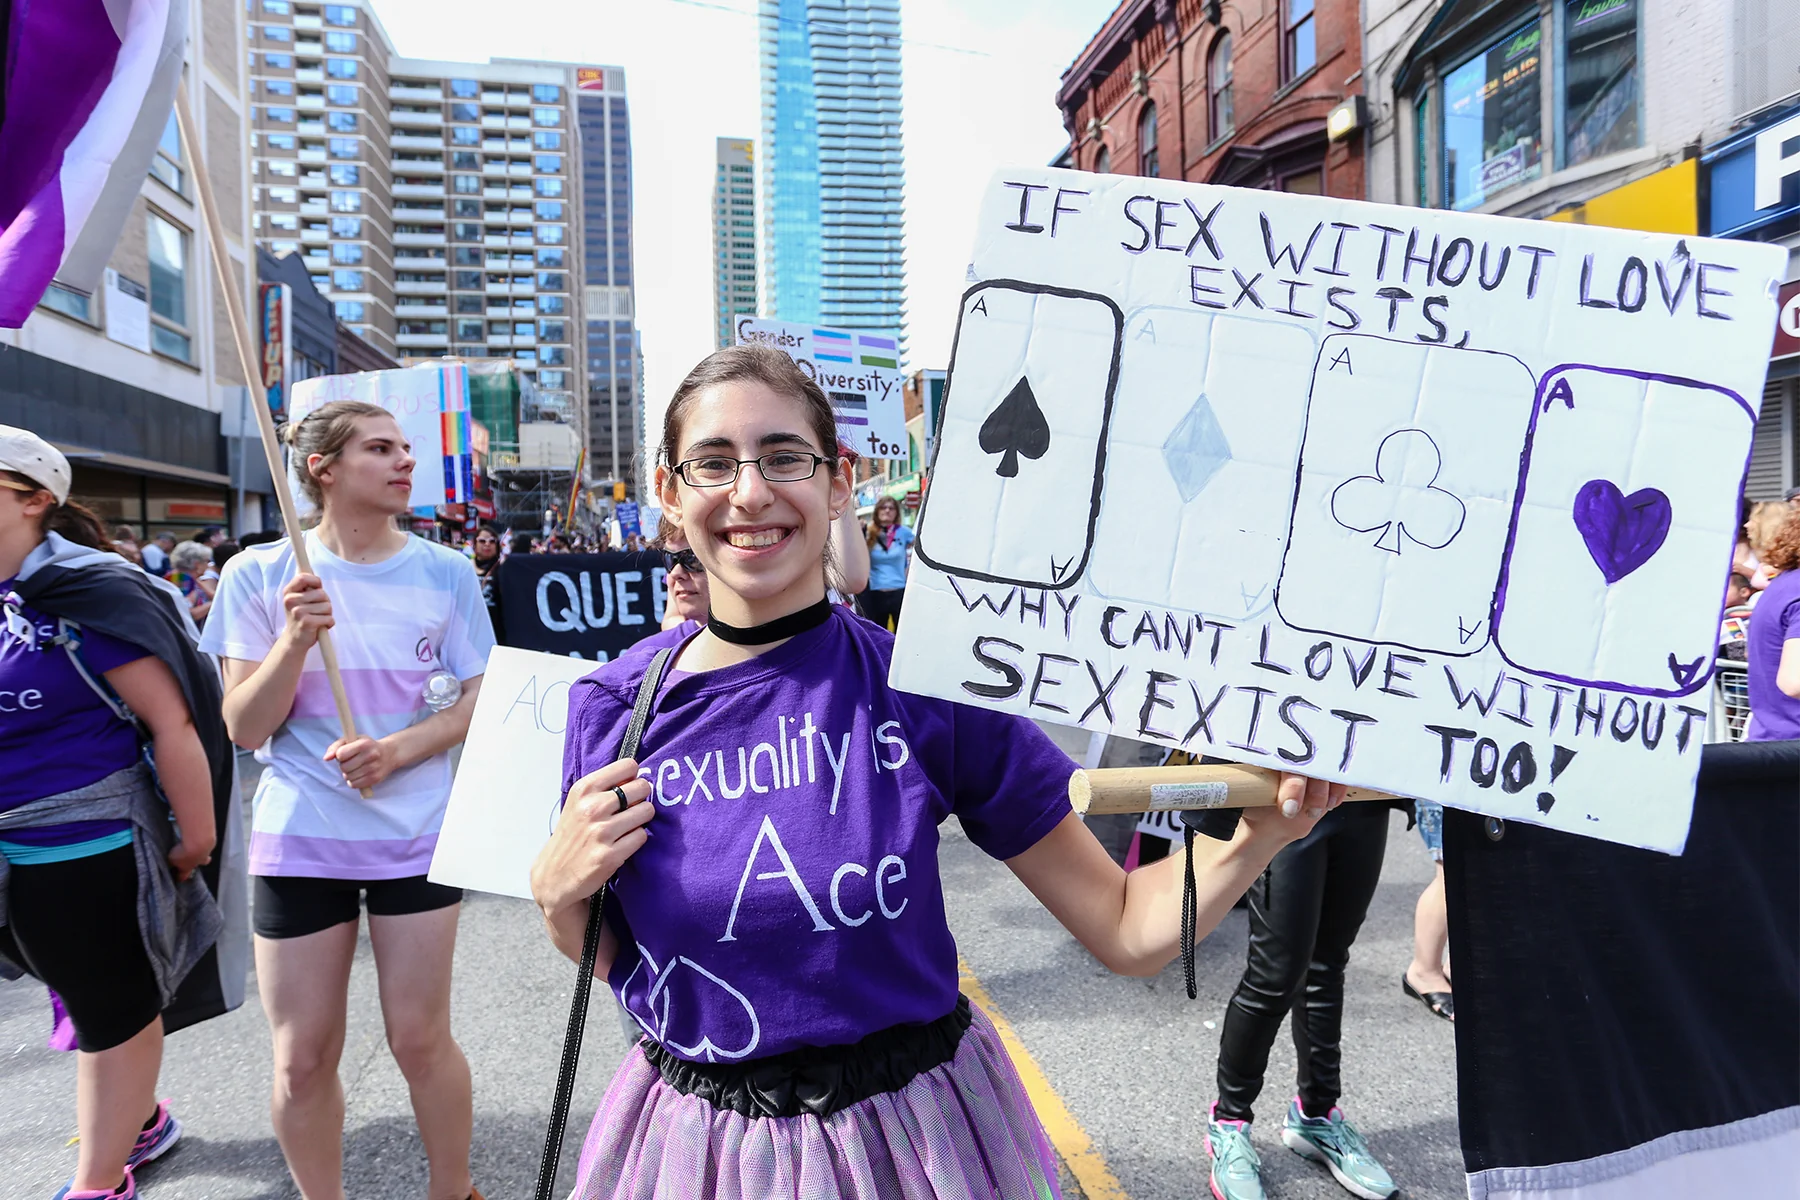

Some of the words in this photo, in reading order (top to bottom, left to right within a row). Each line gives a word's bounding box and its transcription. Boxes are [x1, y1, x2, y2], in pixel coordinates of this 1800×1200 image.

[1003, 181, 1091, 239] IF
[1121, 195, 1226, 261] SEX
[1259, 211, 1556, 300] WITHOUT
[1577, 239, 1739, 321] LOVE
[970, 295, 988, 318] A
[1135, 318, 1157, 345] A
[1188, 264, 1471, 349] EXISTS,
[738, 318, 805, 349] Gender
[1328, 347, 1353, 375] A
[1543, 377, 1575, 413] A
[866, 430, 907, 456] too.
[948, 575, 1081, 642] WHY
[1100, 605, 1237, 670] CAN'T
[1250, 621, 1429, 700] LOVE
[1443, 664, 1707, 756] WITHOUT
[868, 704, 910, 774] is
[961, 635, 1129, 727] SEX
[1136, 668, 1380, 774] EXIST
[1424, 723, 1578, 816] TOO!
[717, 814, 909, 943] Ace
